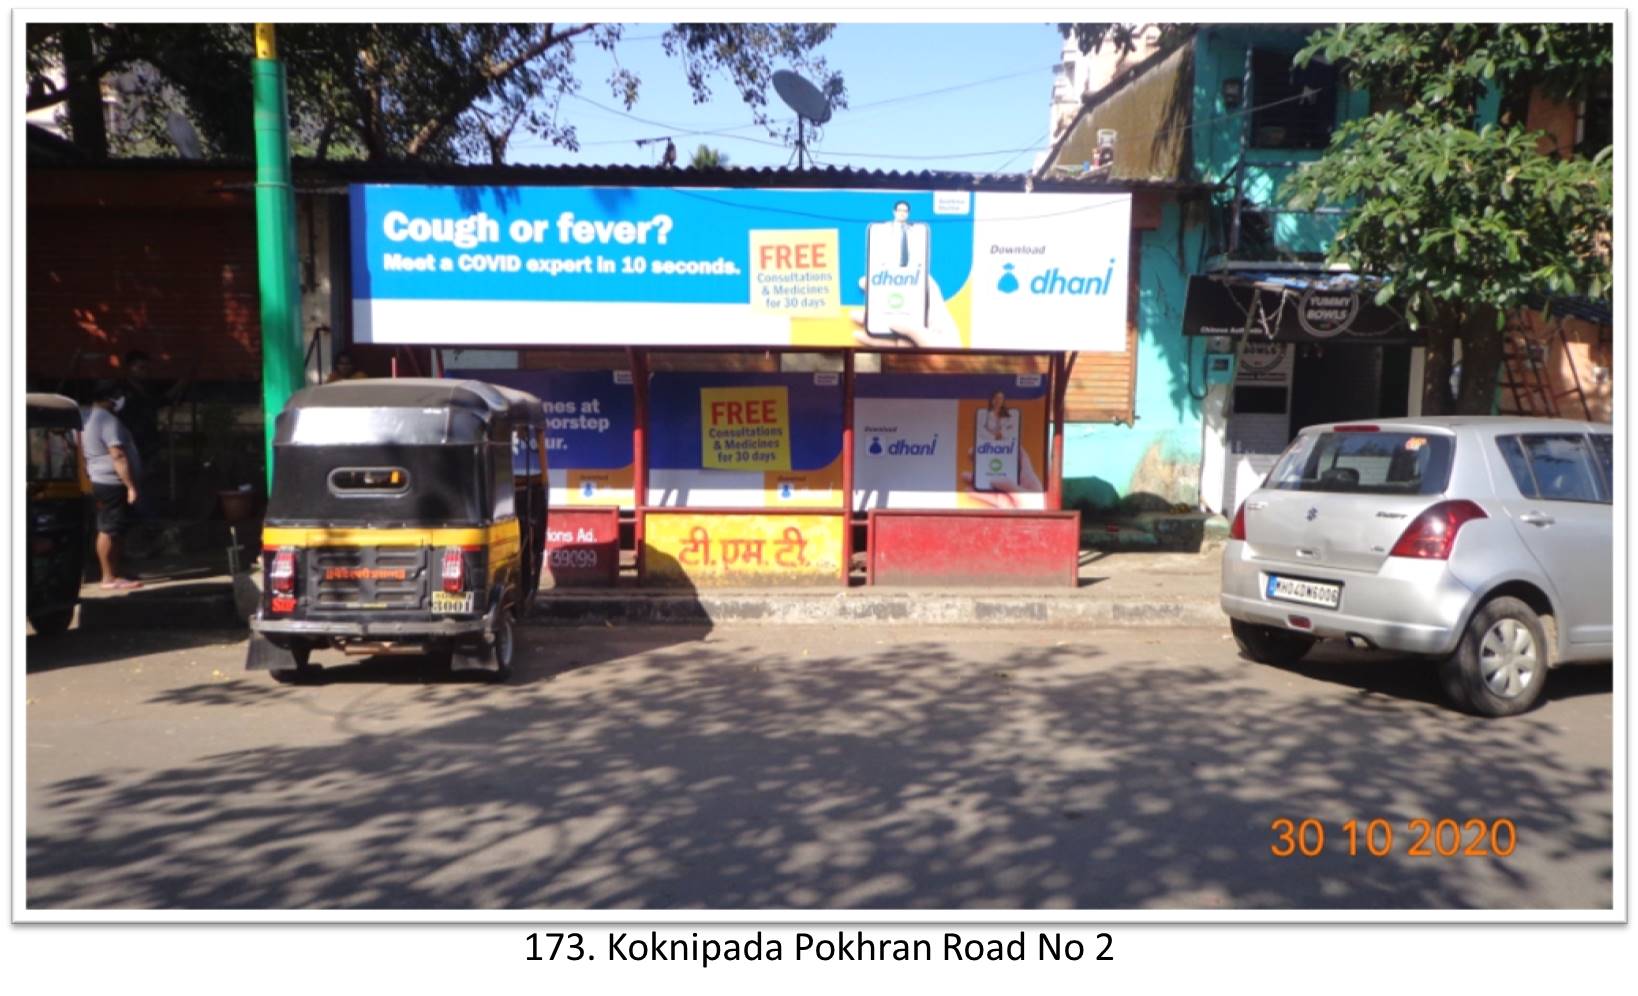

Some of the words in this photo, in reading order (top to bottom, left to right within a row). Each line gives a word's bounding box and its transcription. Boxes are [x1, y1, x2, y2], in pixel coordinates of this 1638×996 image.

[383, 211, 499, 248] Cough
[509, 219, 549, 242] or
[556, 211, 674, 245] fever?
[760, 243, 827, 270] FREE
[990, 244, 1046, 256] Download
[384, 253, 436, 271] Meet
[440, 258, 454, 271] a
[458, 253, 522, 272] COVID
[527, 256, 593, 276] expert
[597, 255, 616, 272] in
[623, 256, 647, 273] 10
[652, 257, 742, 275] seconds.
[757, 272, 833, 284] Consultations
[871, 263, 922, 287] dhani
[1029, 257, 1116, 296] dhani
[761, 286, 769, 296] &
[773, 284, 830, 296] Medicines
[765, 298, 781, 309] for
[784, 298, 798, 308] 30
[801, 298, 826, 309] days
[1306, 309, 1347, 320] BOWLS
[581, 399, 600, 414] at
[711, 400, 778, 425] FREE
[708, 427, 783, 438] Consultations
[713, 441, 722, 450] &
[724, 439, 780, 450] Medicines
[887, 433, 939, 456] dhani
[976, 437, 1015, 455] dhani
[717, 452, 733, 463] for
[736, 451, 750, 462] 30
[751, 451, 777, 462] days
